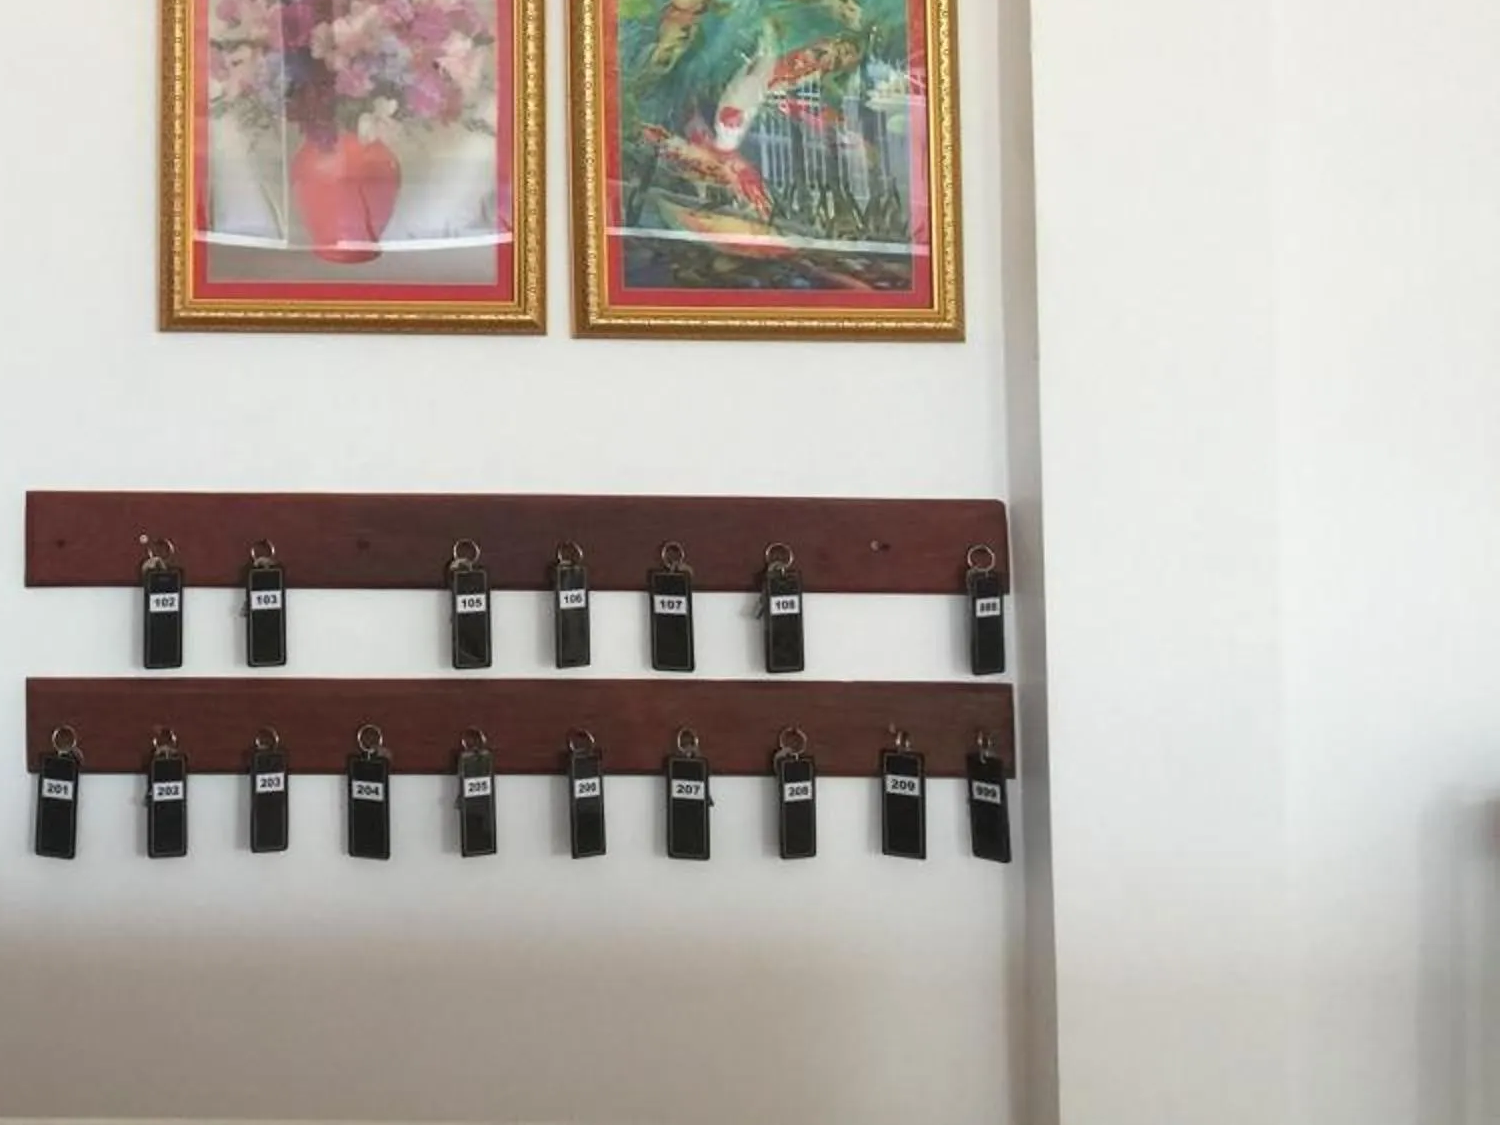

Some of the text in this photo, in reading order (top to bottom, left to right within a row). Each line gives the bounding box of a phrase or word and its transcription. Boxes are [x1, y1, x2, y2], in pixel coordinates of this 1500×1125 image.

[154, 597, 176, 608] 102
[256, 594, 278, 605] 103
[461, 597, 483, 608] 105
[564, 593, 583, 604] 106
[660, 599, 683, 610] 107
[260, 777, 281, 788] 203
[891, 778, 916, 791] 209
[47, 782, 68, 795] 201
[157, 785, 180, 796] 202
[357, 784, 379, 796] 204
[676, 784, 701, 795] 207
